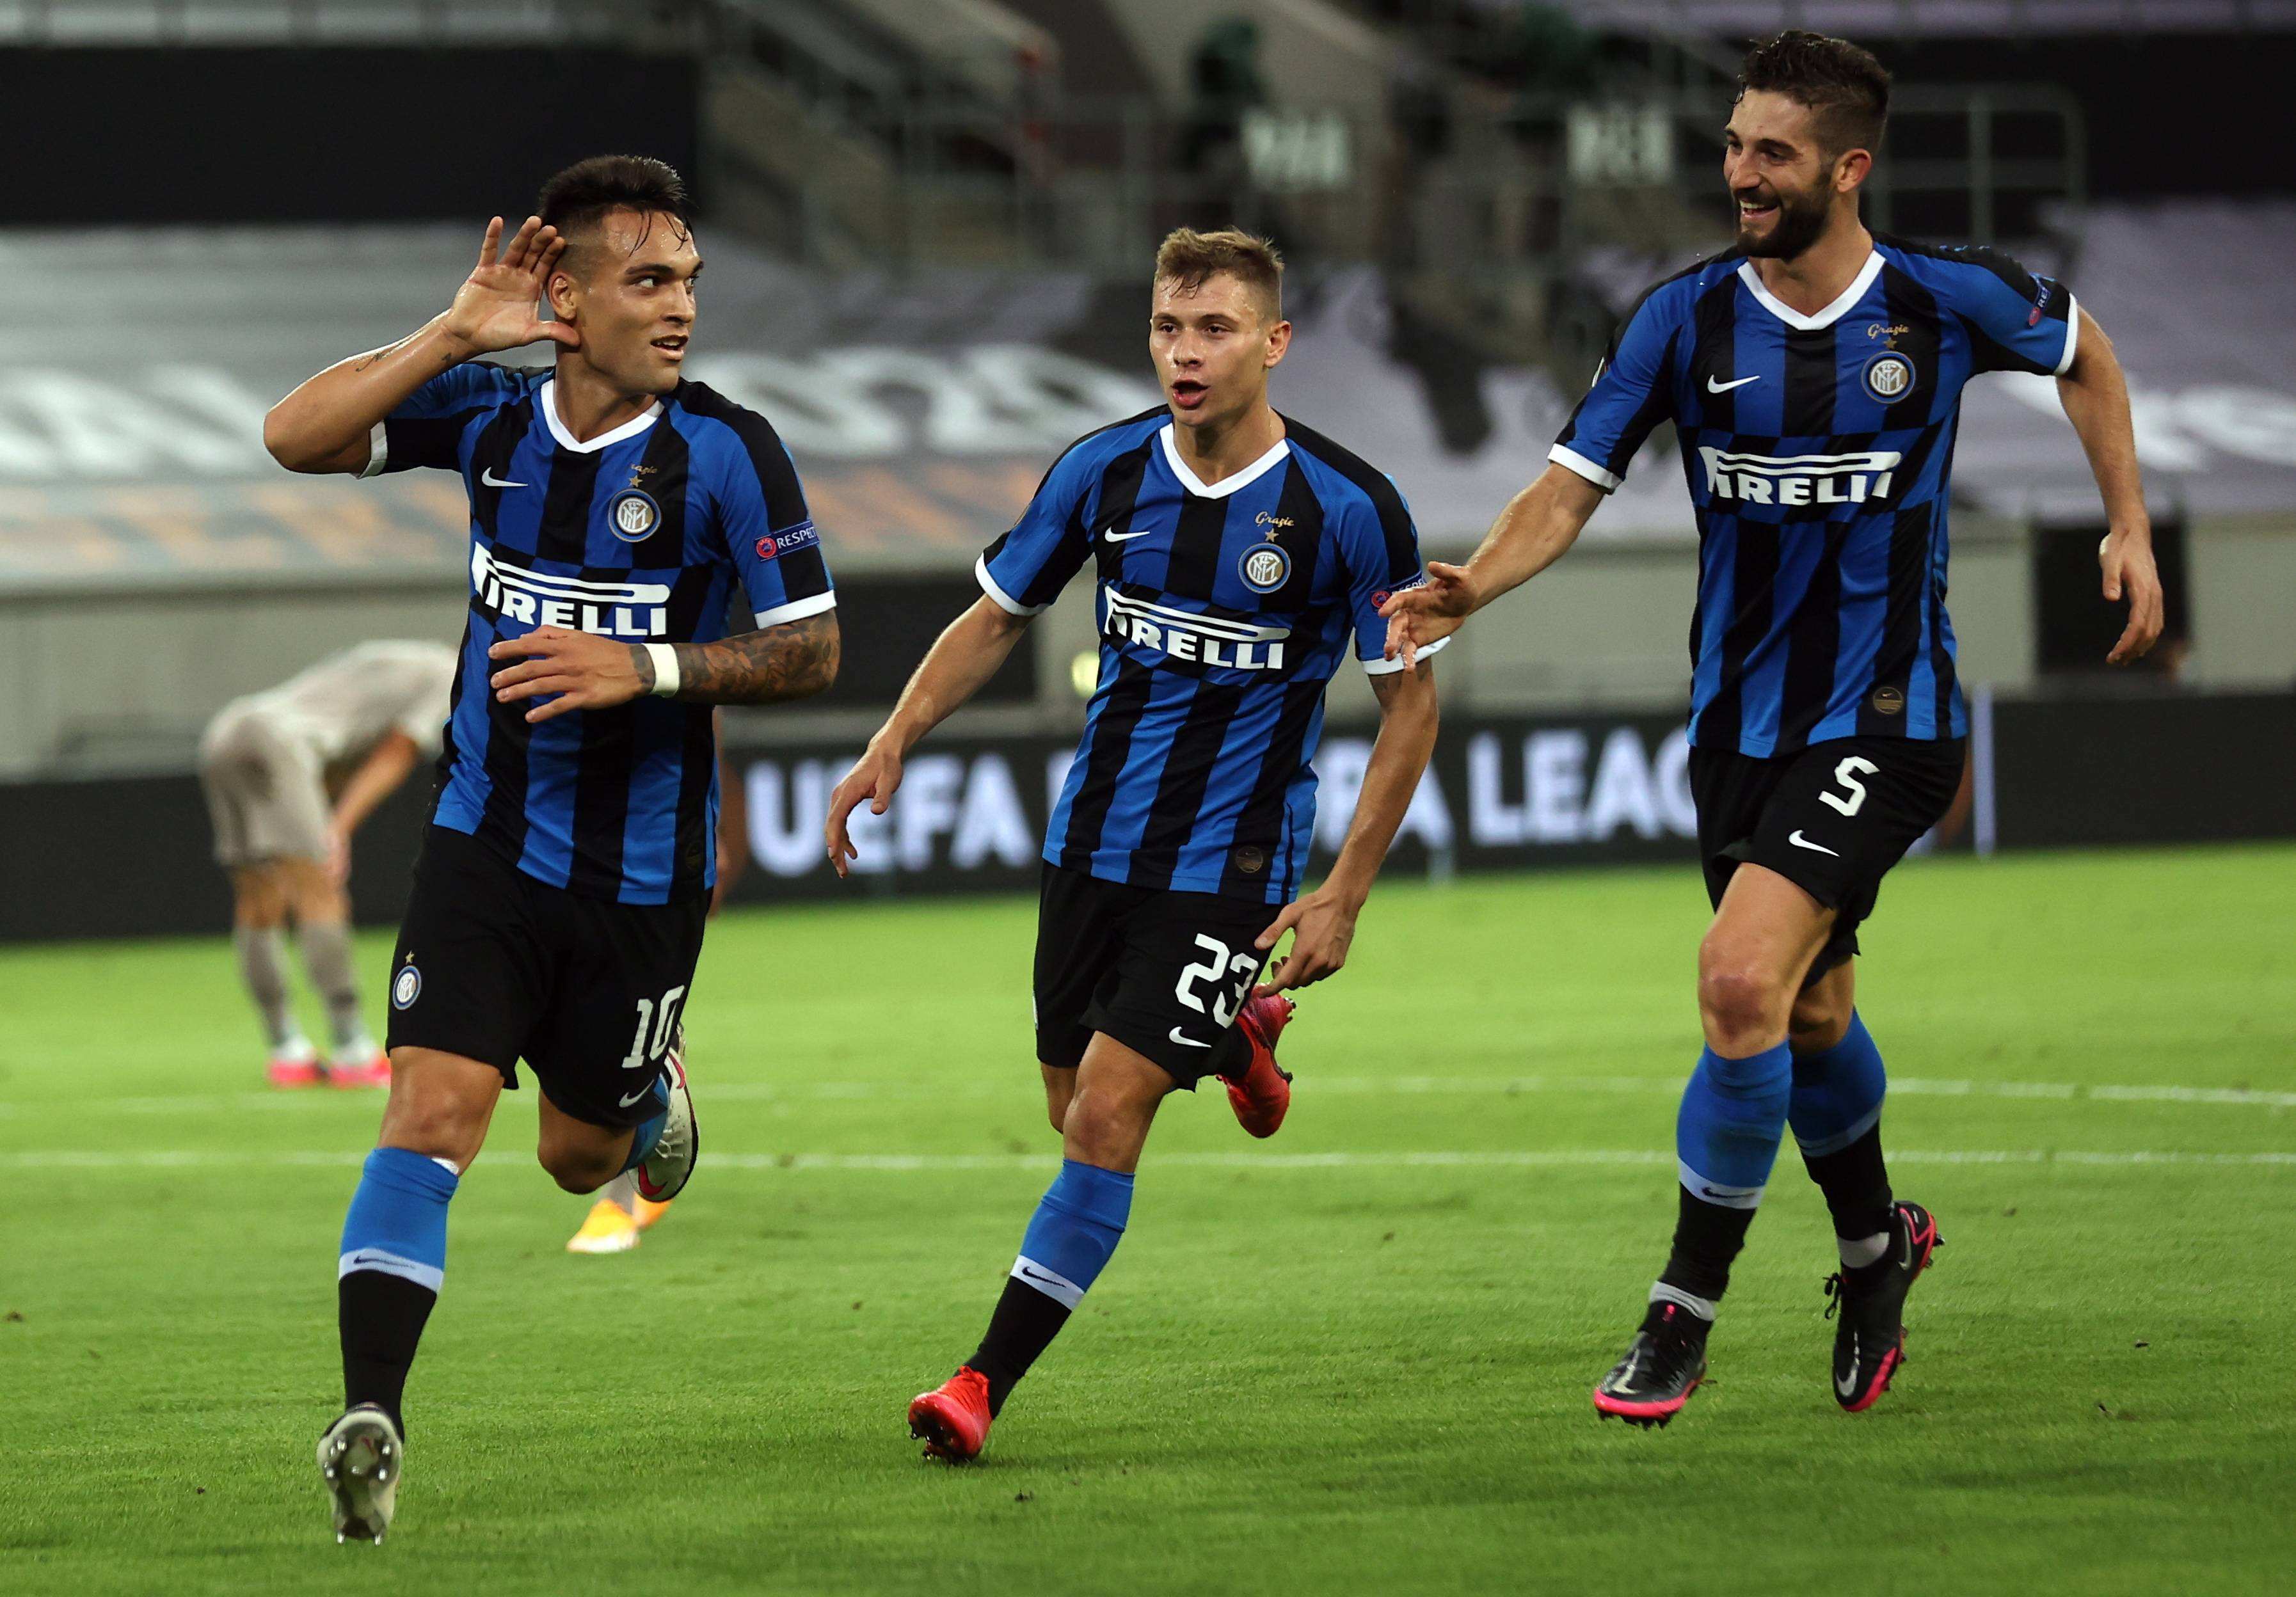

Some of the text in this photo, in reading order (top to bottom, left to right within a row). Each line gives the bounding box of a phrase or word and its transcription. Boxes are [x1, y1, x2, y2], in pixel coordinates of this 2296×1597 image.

[1867, 323, 1909, 340] Grazie
[1698, 447, 1901, 505] PIRELLI
[1255, 511, 1295, 528] Grazie
[472, 541, 671, 636] PIRELLI
[1104, 585, 1290, 669] PIRELLI
[1176, 933, 1259, 1029] 23
[621, 985, 685, 1068] 10
